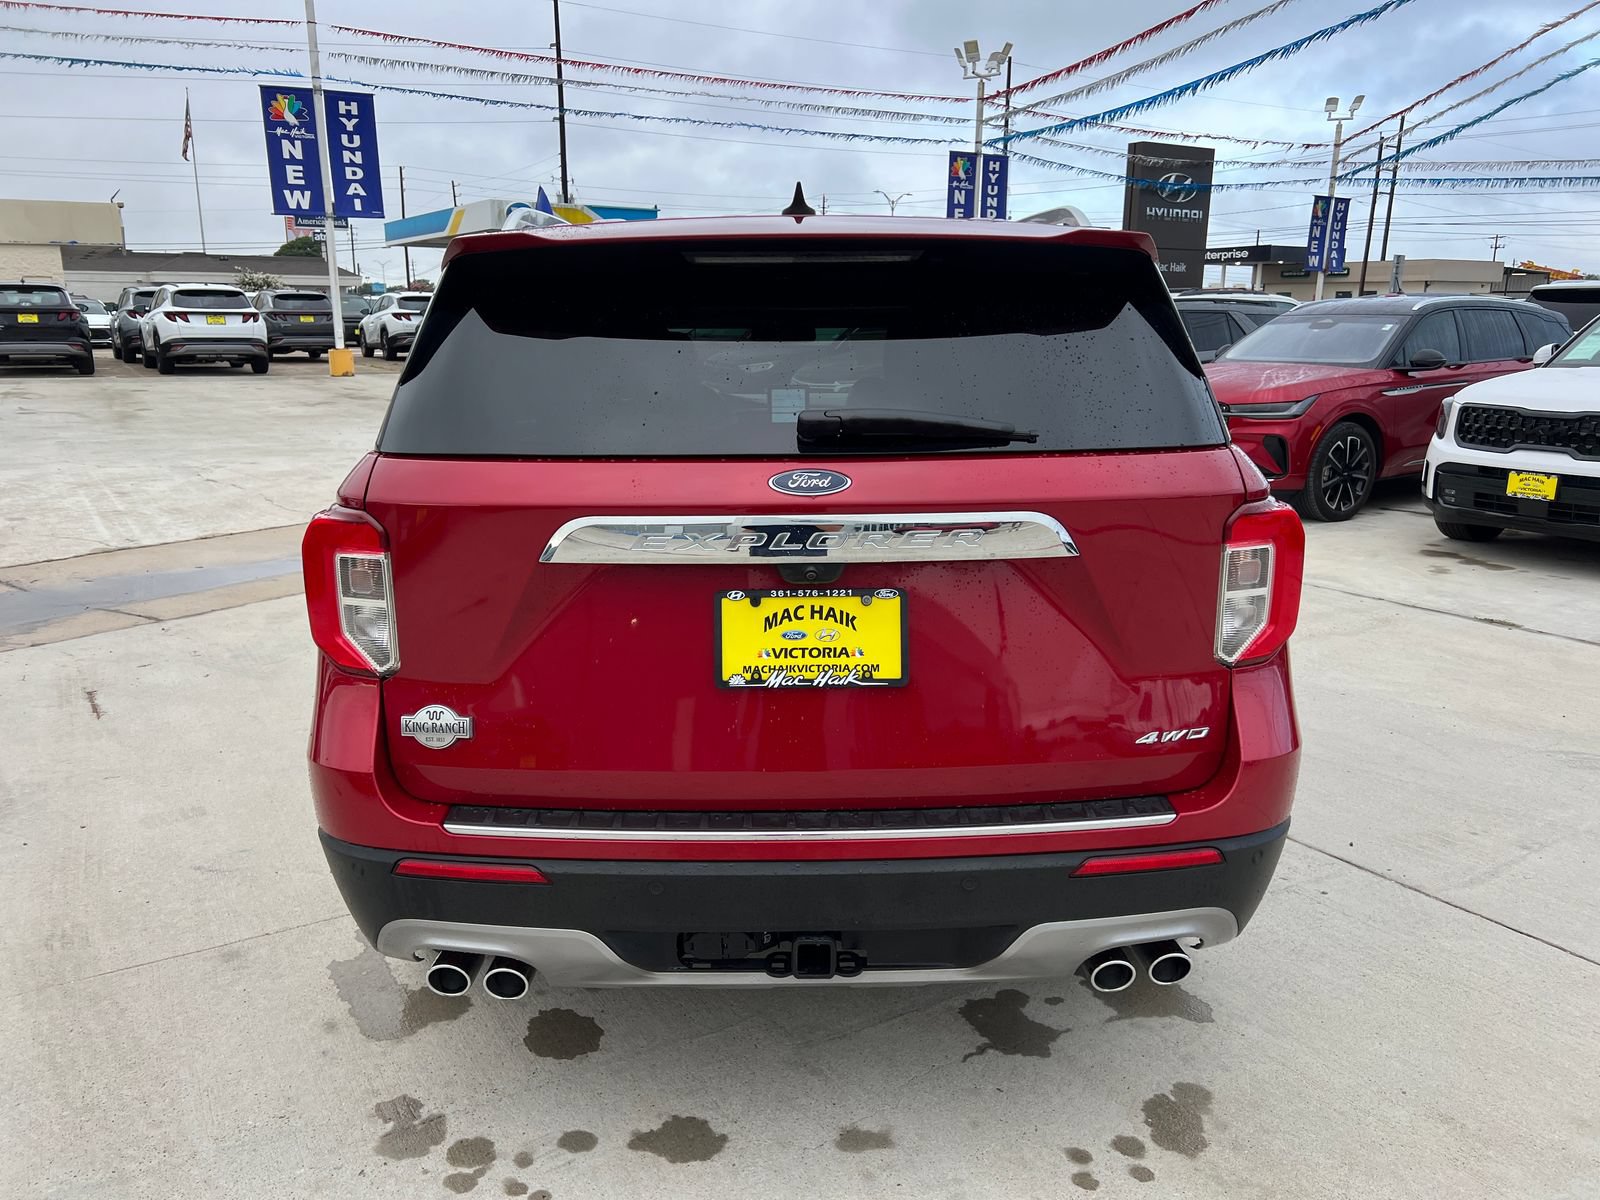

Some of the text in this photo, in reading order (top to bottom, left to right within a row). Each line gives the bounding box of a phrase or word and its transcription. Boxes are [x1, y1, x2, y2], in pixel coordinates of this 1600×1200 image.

[338, 101, 367, 211] HYUNDAI
[281, 139, 312, 210] NEW
[986, 161, 1000, 219] HYUND
[954, 190, 966, 218] NE
[297, 217, 326, 225] America
[1146, 206, 1203, 222] HYUNDAI
[1330, 203, 1345, 267] HYUNDAI
[1204, 249, 1249, 261] terprise
[1308, 226, 1321, 267] NEW
[1169, 262, 1187, 273] Haik
[788, 472, 832, 488] Ford
[630, 528, 988, 552] EXPLORER
[770, 589, 853, 598] 361-576-1221
[764, 605, 858, 633] MAC HAIK
[785, 631, 803, 639] Ford
[772, 647, 851, 659] VICTORIA
[742, 664, 881, 674] MACHAIKVICTORIA.COM
[765, 669, 812, 688] Mac
[404, 720, 466, 734] KING RANCH
[1135, 726, 1210, 744] 4WD
